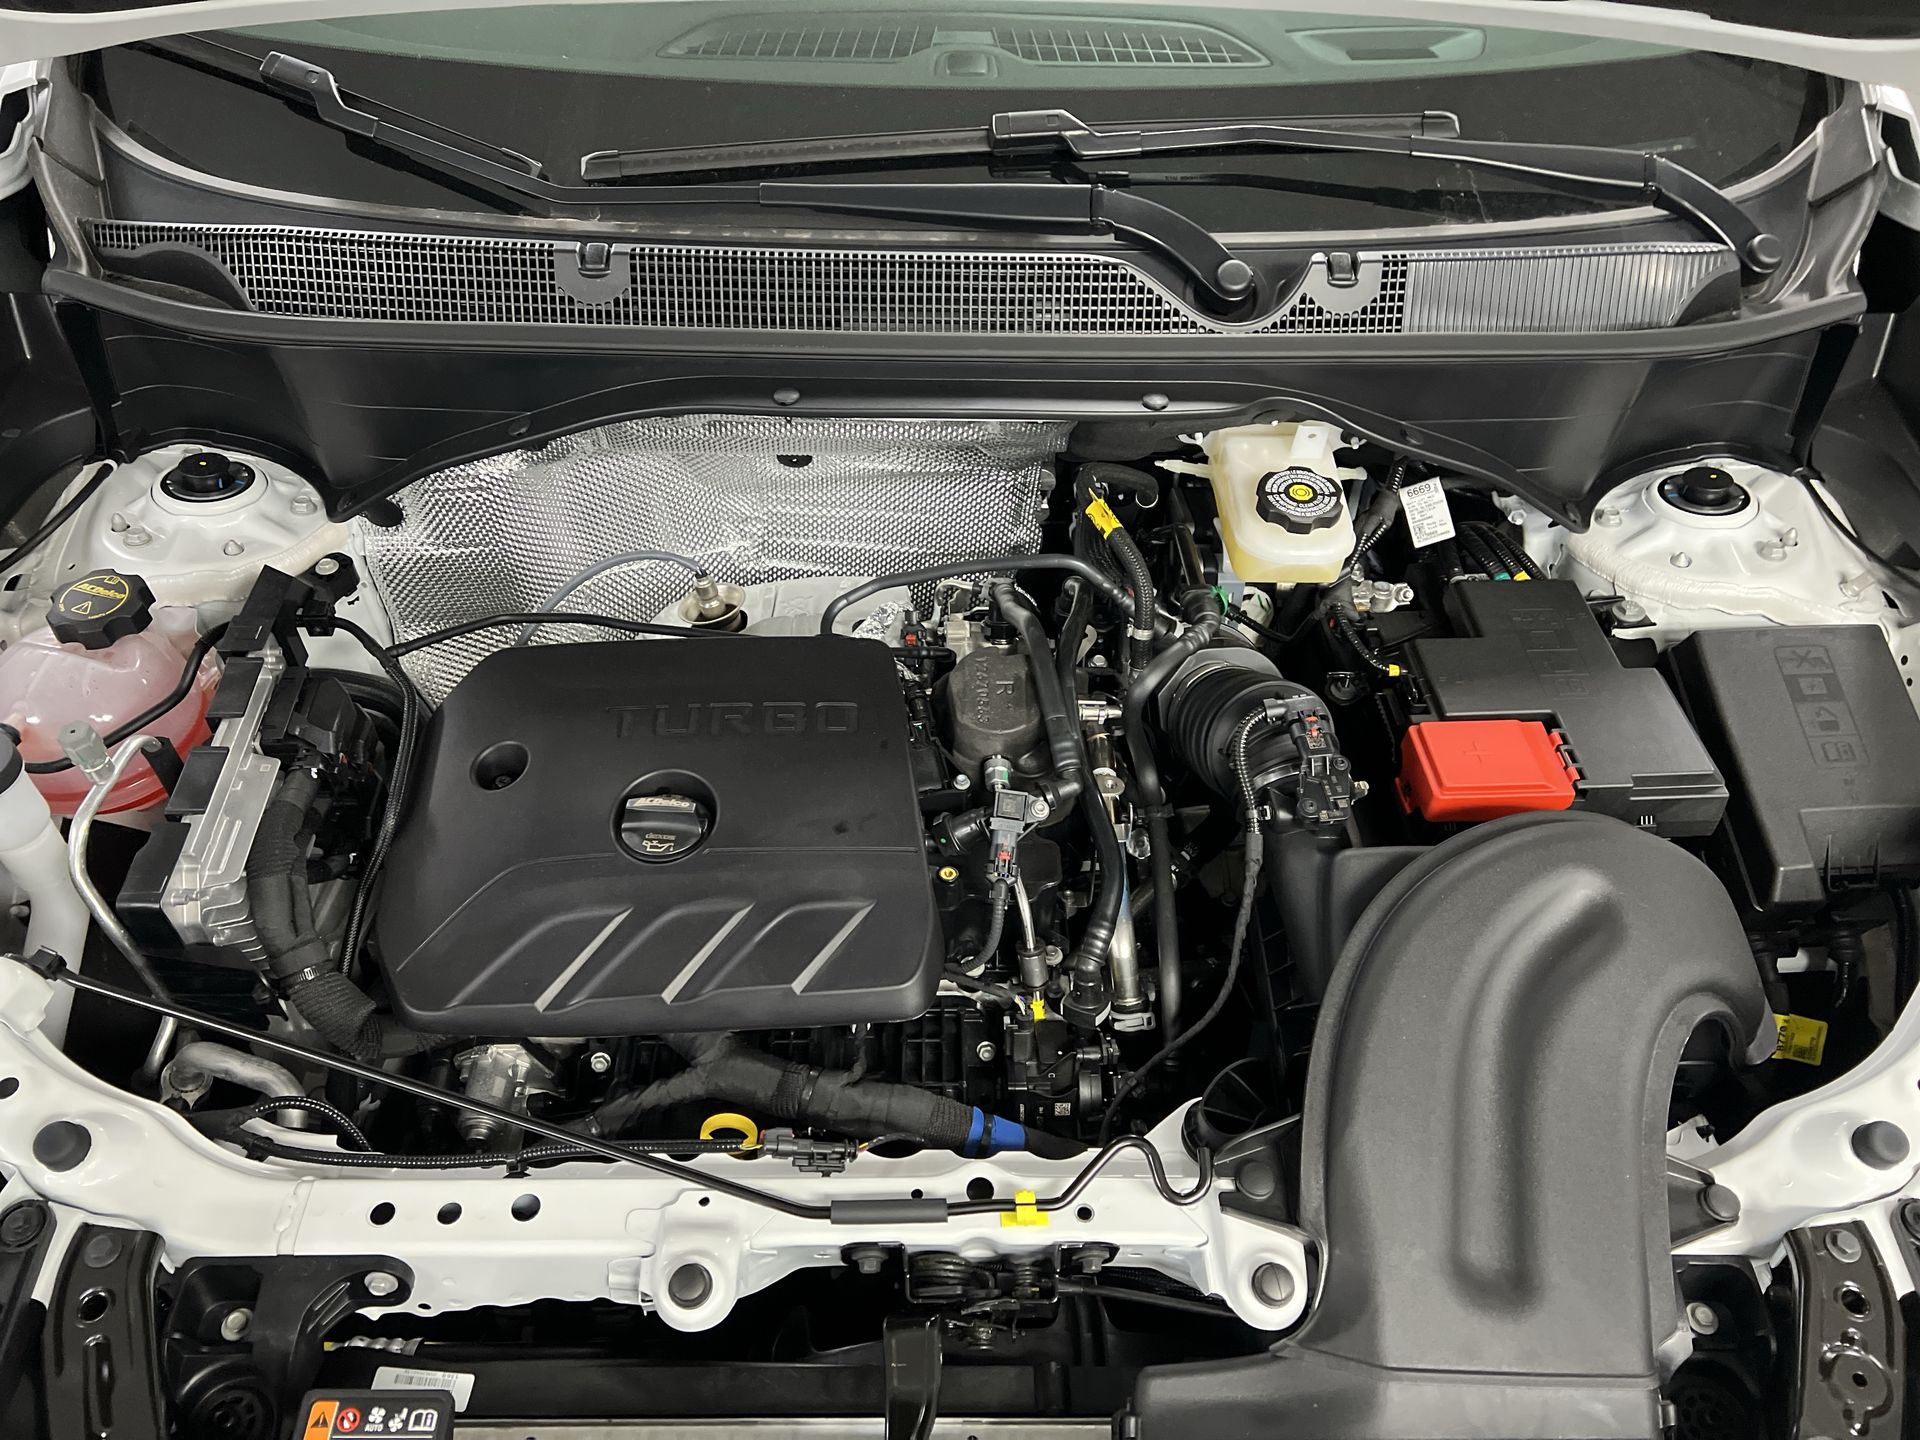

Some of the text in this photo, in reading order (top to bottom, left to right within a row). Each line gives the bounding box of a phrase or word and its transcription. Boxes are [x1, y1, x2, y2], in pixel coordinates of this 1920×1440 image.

[1406, 483, 1431, 498] 6669
[75, 583, 126, 598] ACDelco
[996, 680, 1015, 695] R
[605, 701, 859, 738] TURBO
[633, 797, 690, 807] ACDelco
[365, 1423, 383, 1432] AUTO
